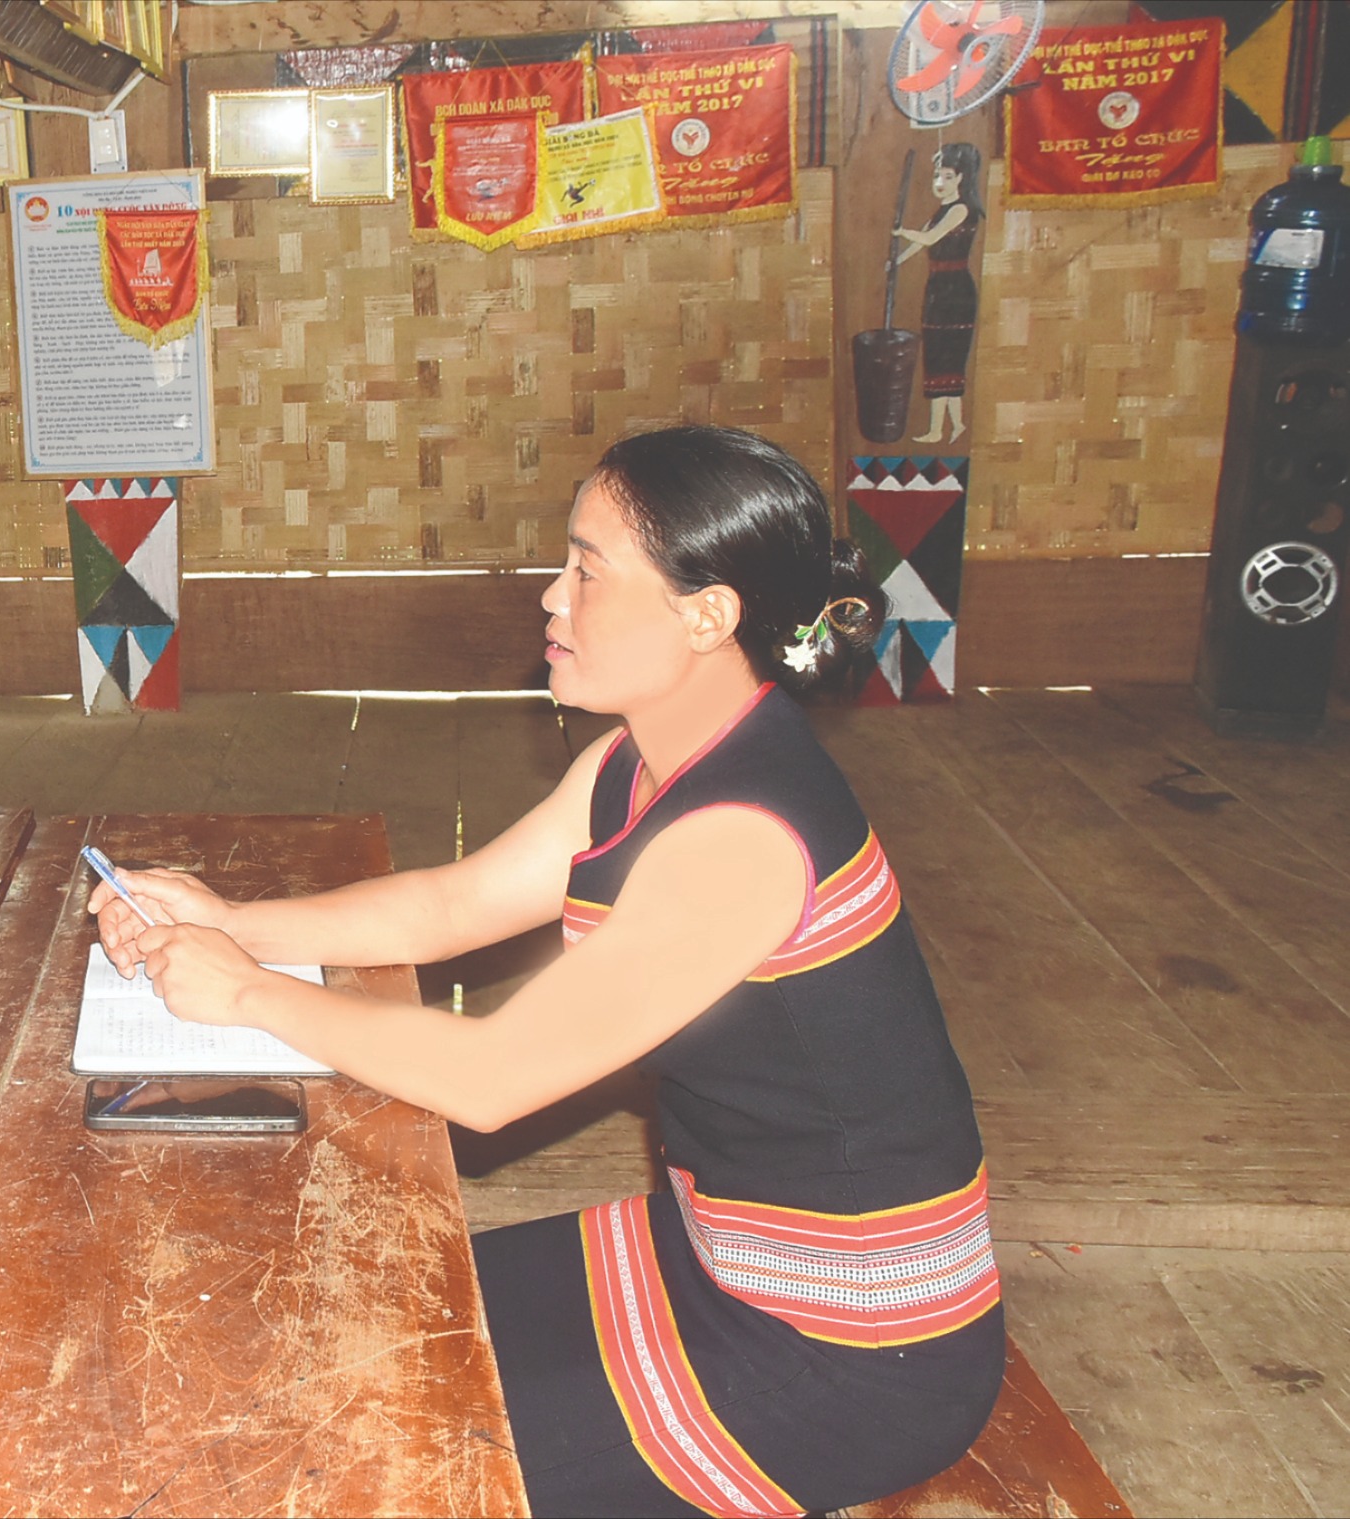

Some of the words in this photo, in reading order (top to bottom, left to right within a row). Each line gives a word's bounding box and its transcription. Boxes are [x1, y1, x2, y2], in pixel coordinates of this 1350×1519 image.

[1103, 52, 1160, 70] THỨ
[1168, 49, 1196, 63] VI
[679, 79, 731, 97] THỨ
[738, 76, 764, 90] VI
[1062, 74, 1117, 91] NĂM
[1123, 68, 1174, 87] 2017
[436, 102, 456, 117] BCH
[697, 95, 743, 112] 2017
[57, 205, 73, 218] 10
